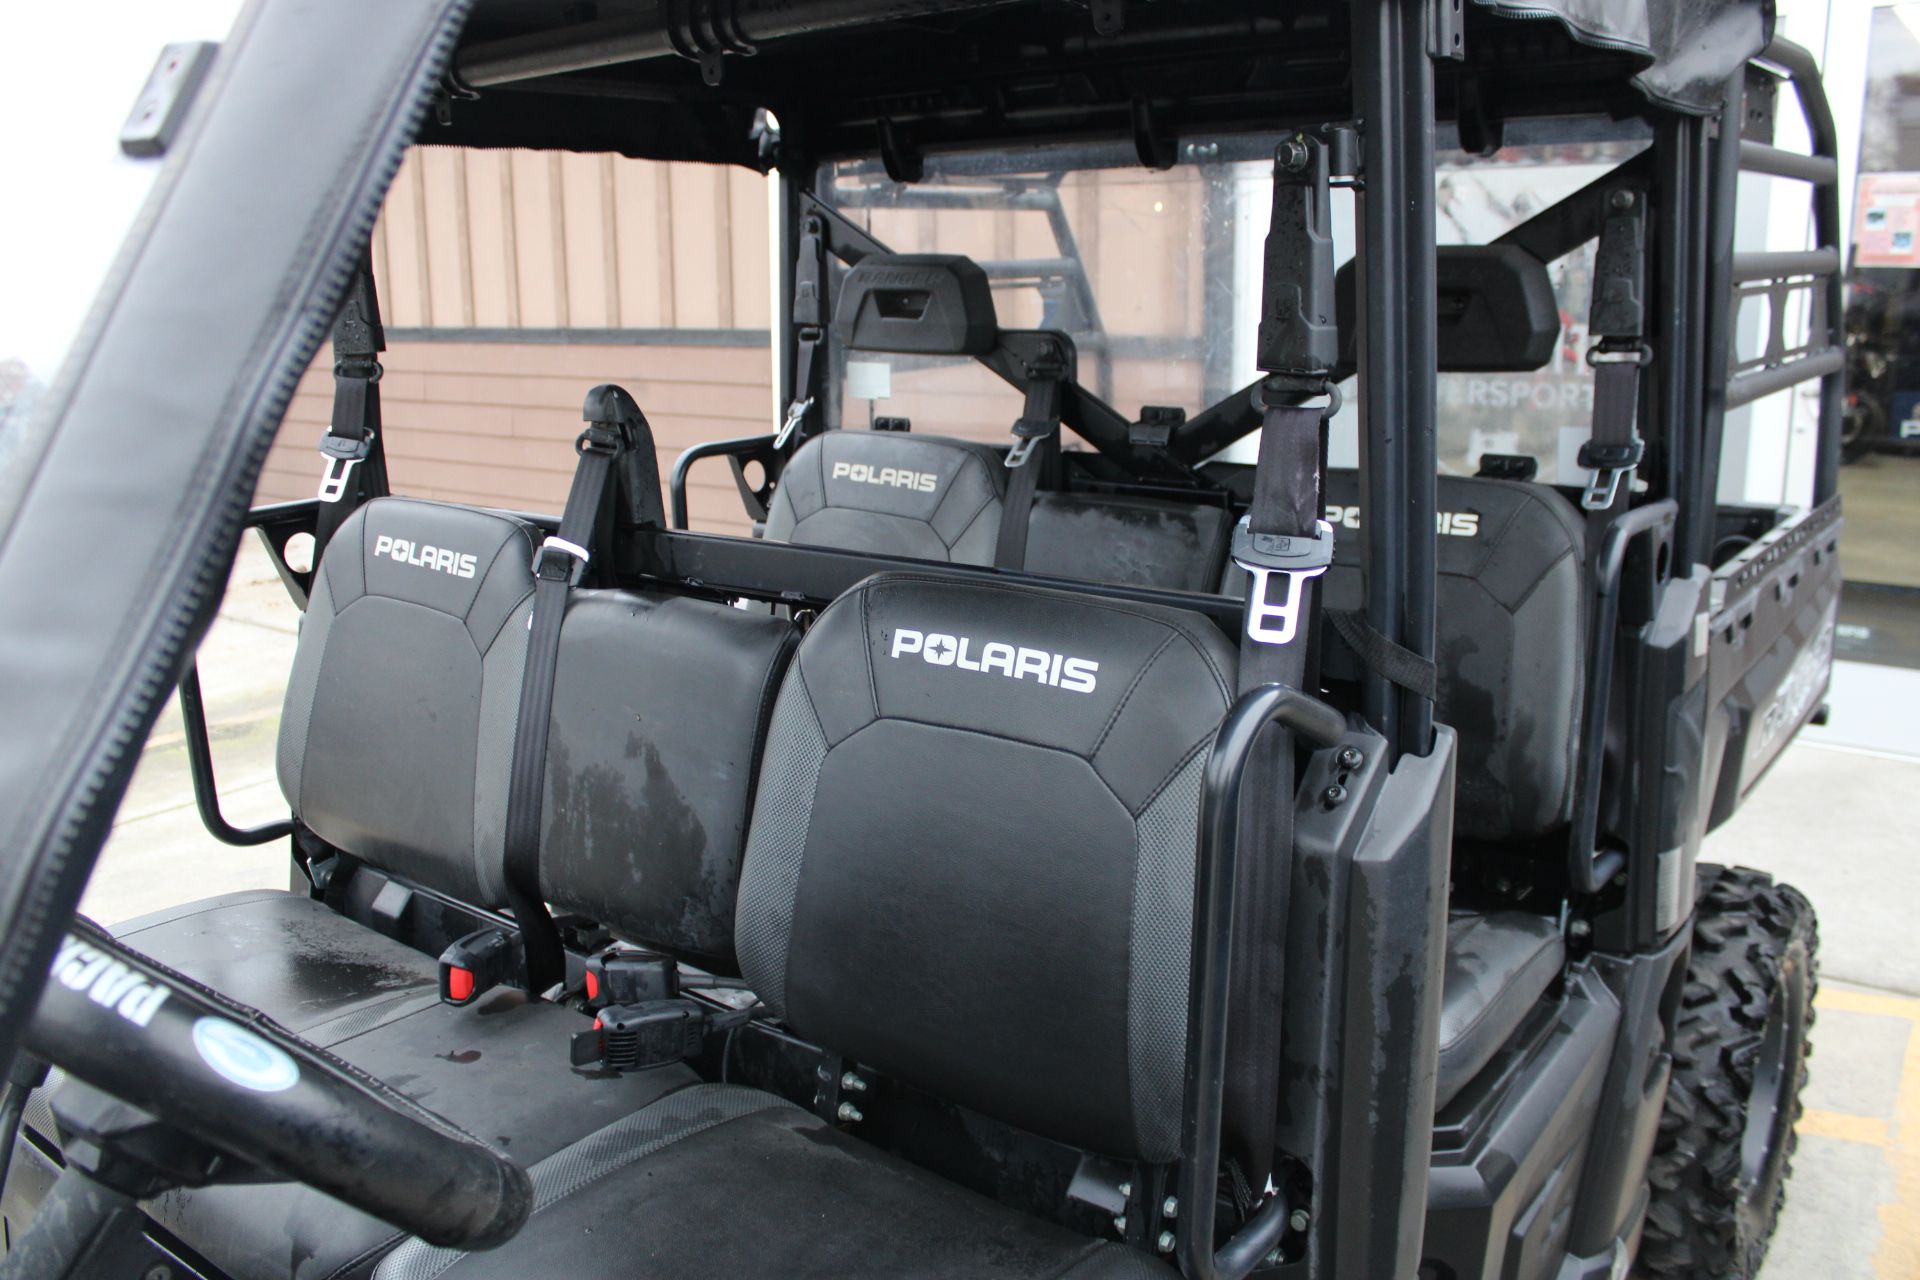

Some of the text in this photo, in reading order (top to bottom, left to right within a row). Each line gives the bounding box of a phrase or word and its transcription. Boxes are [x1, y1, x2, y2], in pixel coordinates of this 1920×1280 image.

[1438, 377, 1595, 411] ERSPORT
[832, 462, 937, 493] POLARIS
[1325, 505, 1479, 537] POIS
[374, 535, 477, 579] POLARIS
[891, 628, 1099, 694] POLARIS
